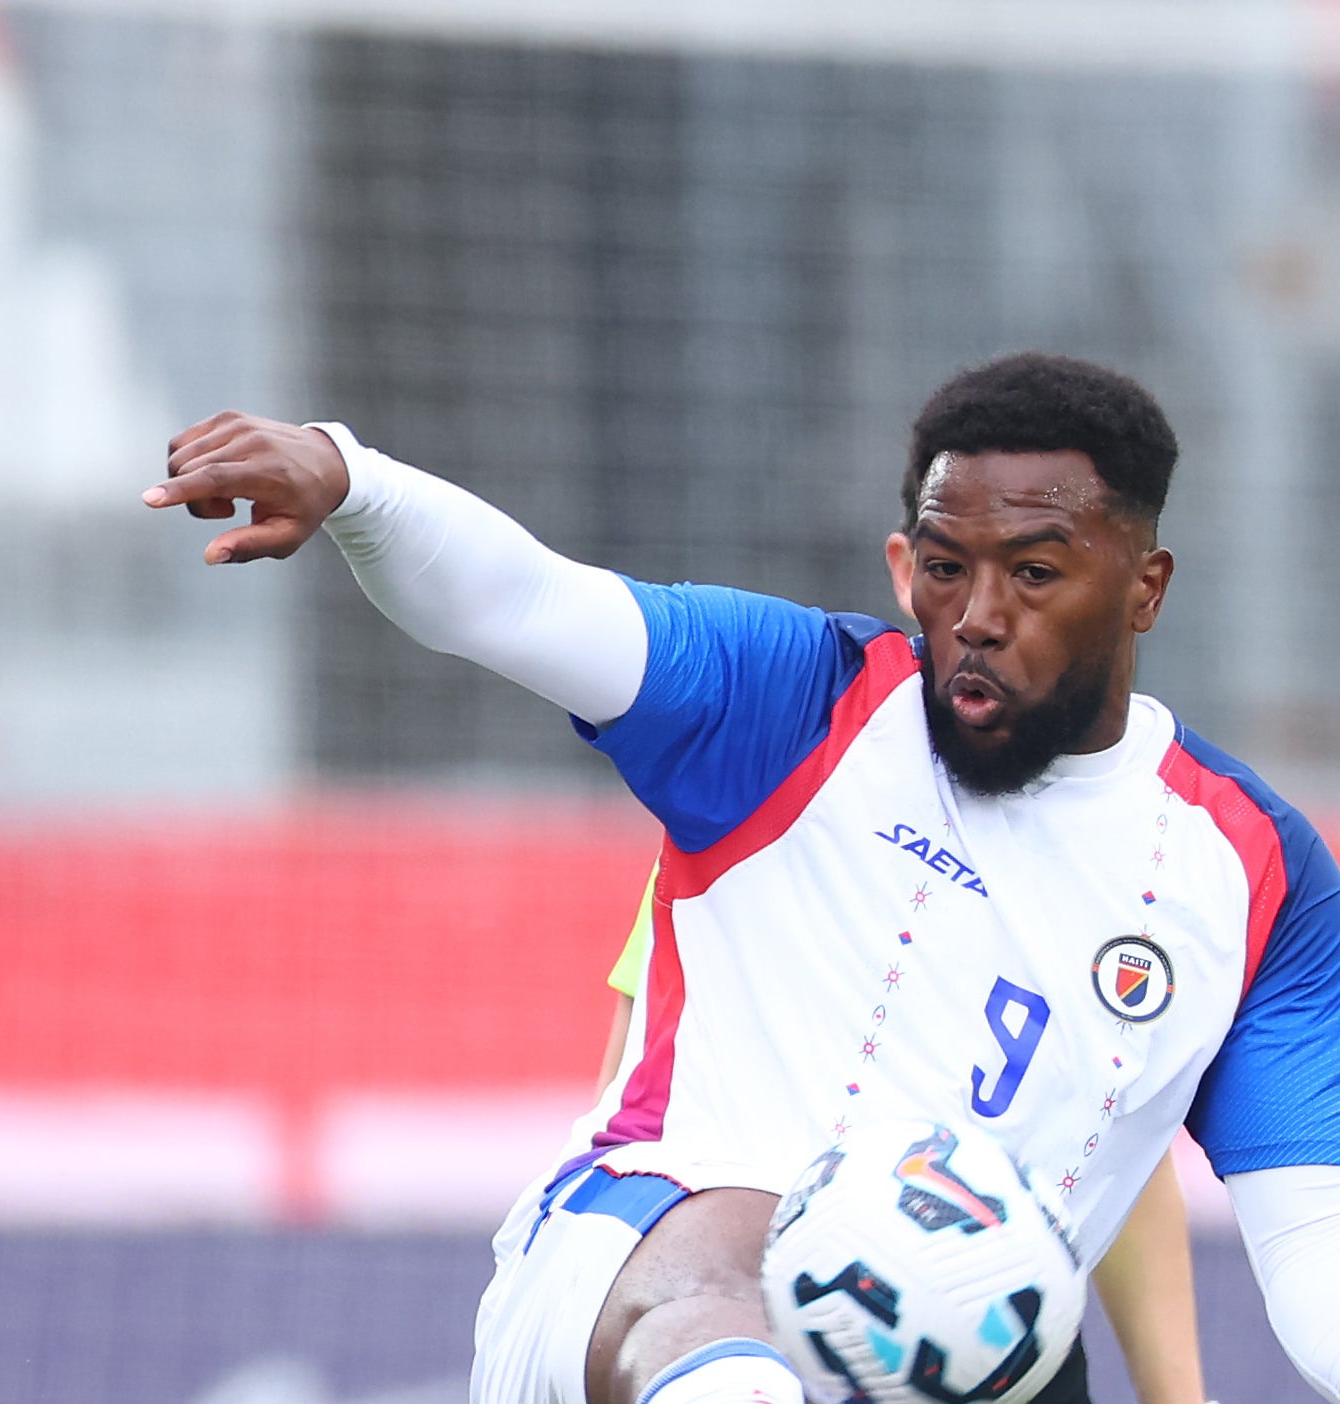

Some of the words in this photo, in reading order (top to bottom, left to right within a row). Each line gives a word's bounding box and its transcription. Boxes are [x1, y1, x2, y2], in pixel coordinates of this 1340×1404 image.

[873, 823, 989, 898] SAETA
[1120, 955, 1151, 970] HAITI
[970, 974, 1051, 1118] 9
